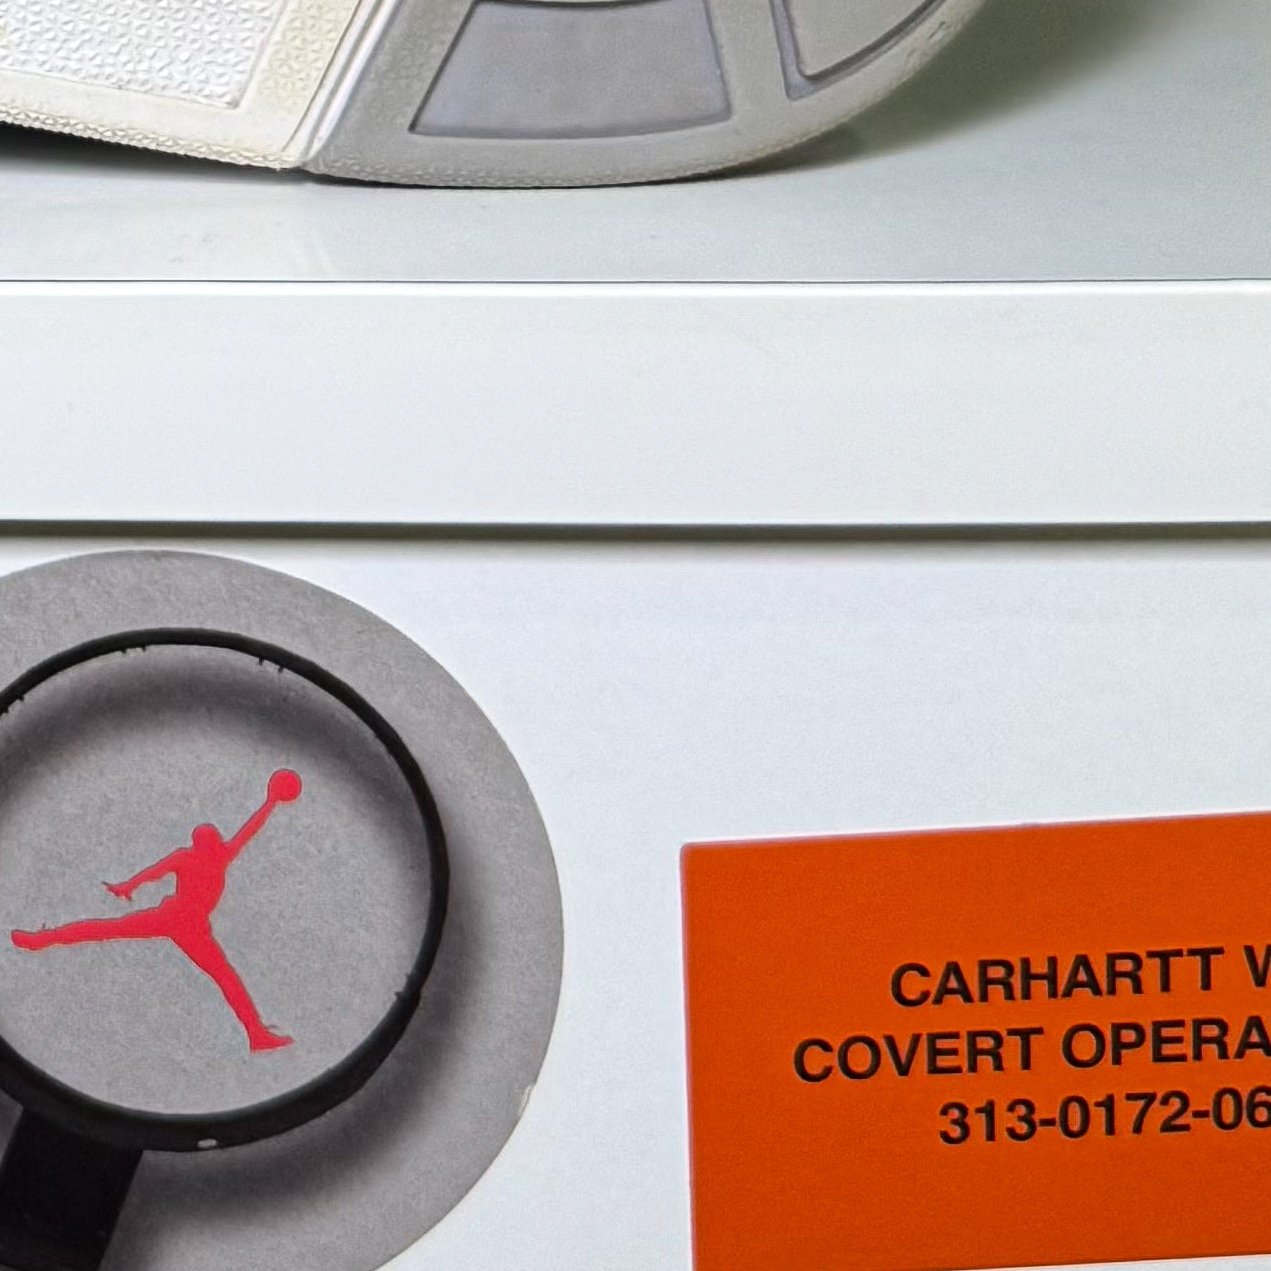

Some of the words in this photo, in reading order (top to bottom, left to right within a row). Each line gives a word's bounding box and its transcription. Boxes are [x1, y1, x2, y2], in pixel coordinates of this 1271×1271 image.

[890, 946, 1226, 1008] CARHARTT
[793, 1025, 1045, 1083] COVERT
[1060, 1015, 1271, 1069] OPERA
[938, 1084, 1271, 1145] 313-0172-06
